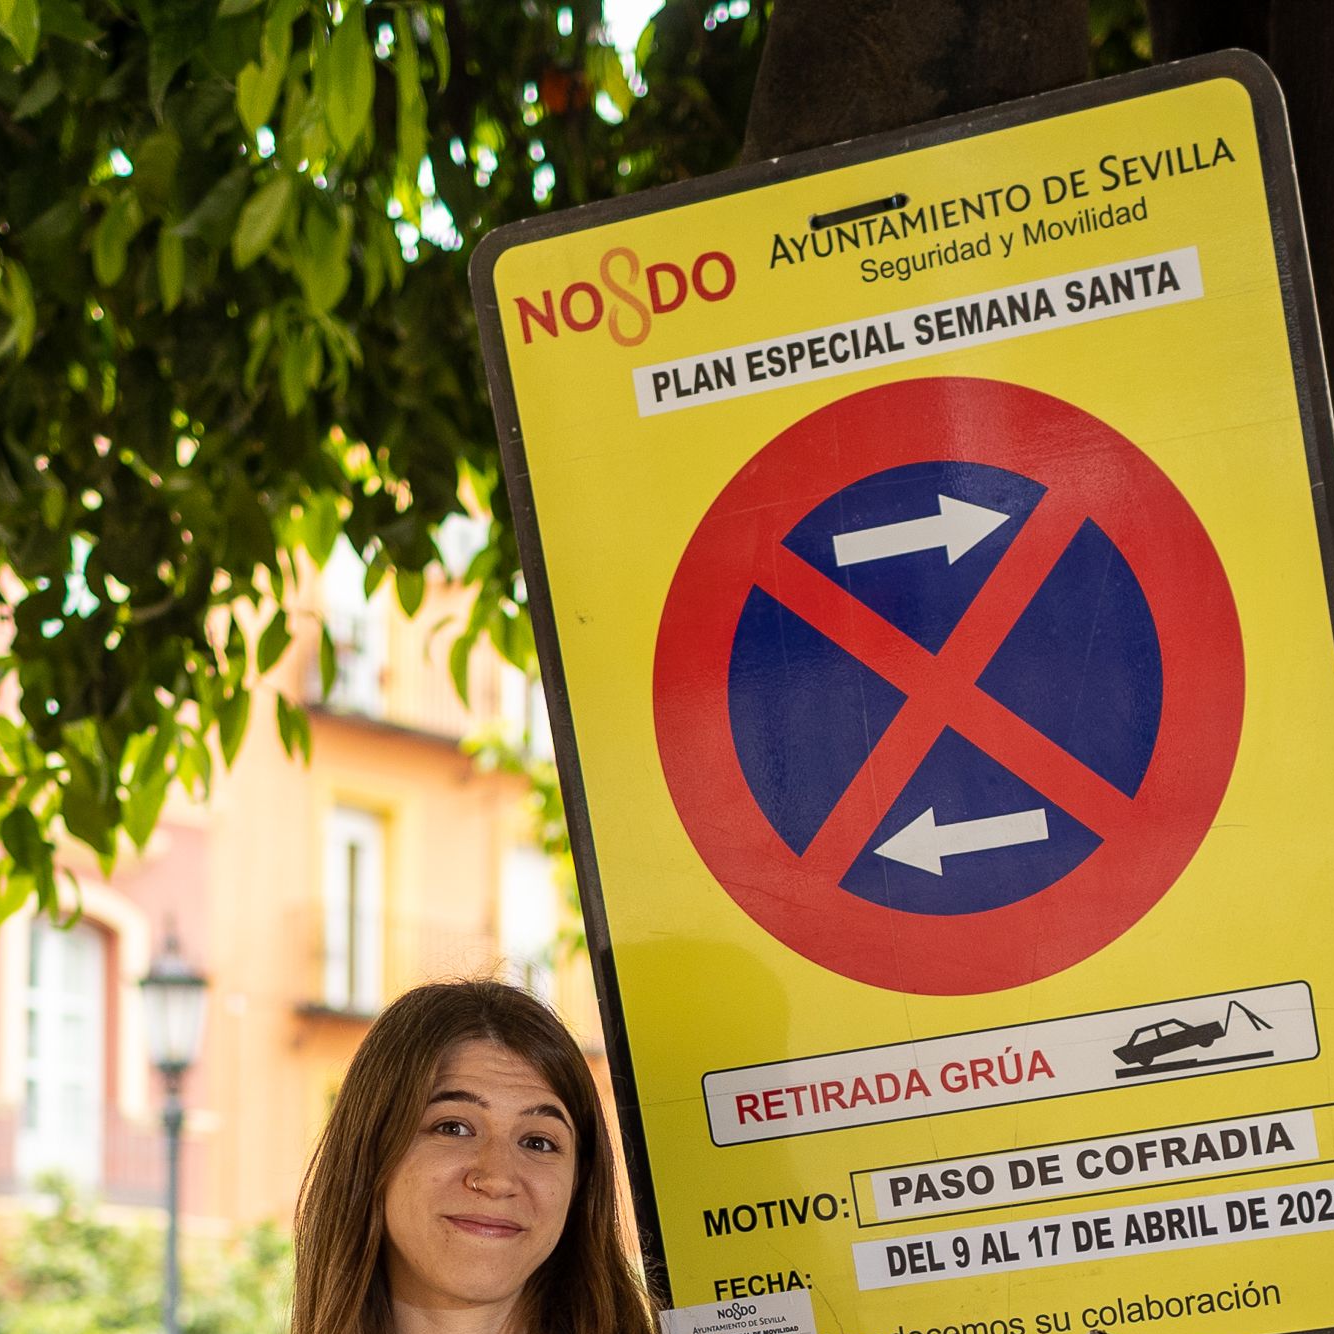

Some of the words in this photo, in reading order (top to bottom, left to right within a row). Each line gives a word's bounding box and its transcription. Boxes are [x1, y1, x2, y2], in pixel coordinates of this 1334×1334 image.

[770, 184, 1031, 269] AYUNTAMIENTO
[1043, 169, 1089, 205] DE
[1099, 137, 1236, 192] SEVILLA
[860, 232, 991, 283] Seguridad
[999, 232, 1014, 258] y
[1023, 196, 1148, 246] Movilidad
[652, 356, 737, 402] PLAN
[746, 322, 905, 382] ESPECIAL
[914, 288, 1056, 345] SEMANA
[1065, 260, 1181, 313] SANTA
[735, 1069, 931, 1124] RETIRADA
[940, 1046, 1056, 1093] GRÚA
[703, 1192, 850, 1237] MOTIVO:
[889, 1165, 995, 1207] PASO
[1008, 1154, 1063, 1190] DE
[1076, 1122, 1295, 1180] COFRADIA
[714, 1270, 813, 1301] FECHA:
[886, 1241, 945, 1277] DEL
[952, 1236, 970, 1268] 9
[981, 1231, 1020, 1265] AL
[1028, 1224, 1061, 1258] 17
[1072, 1217, 1114, 1252] DE
[1124, 1204, 1218, 1246] ABRIL
[1226, 1197, 1269, 1233] DE
[693, 1321, 747, 1334] AYUNTAMIENTO
[759, 1316, 787, 1326] SEVILLA
[763, 1325, 799, 1334] MOVILIDAD
[1036, 1311, 1071, 1334] su
[1082, 1280, 1281, 1329] colaboración
